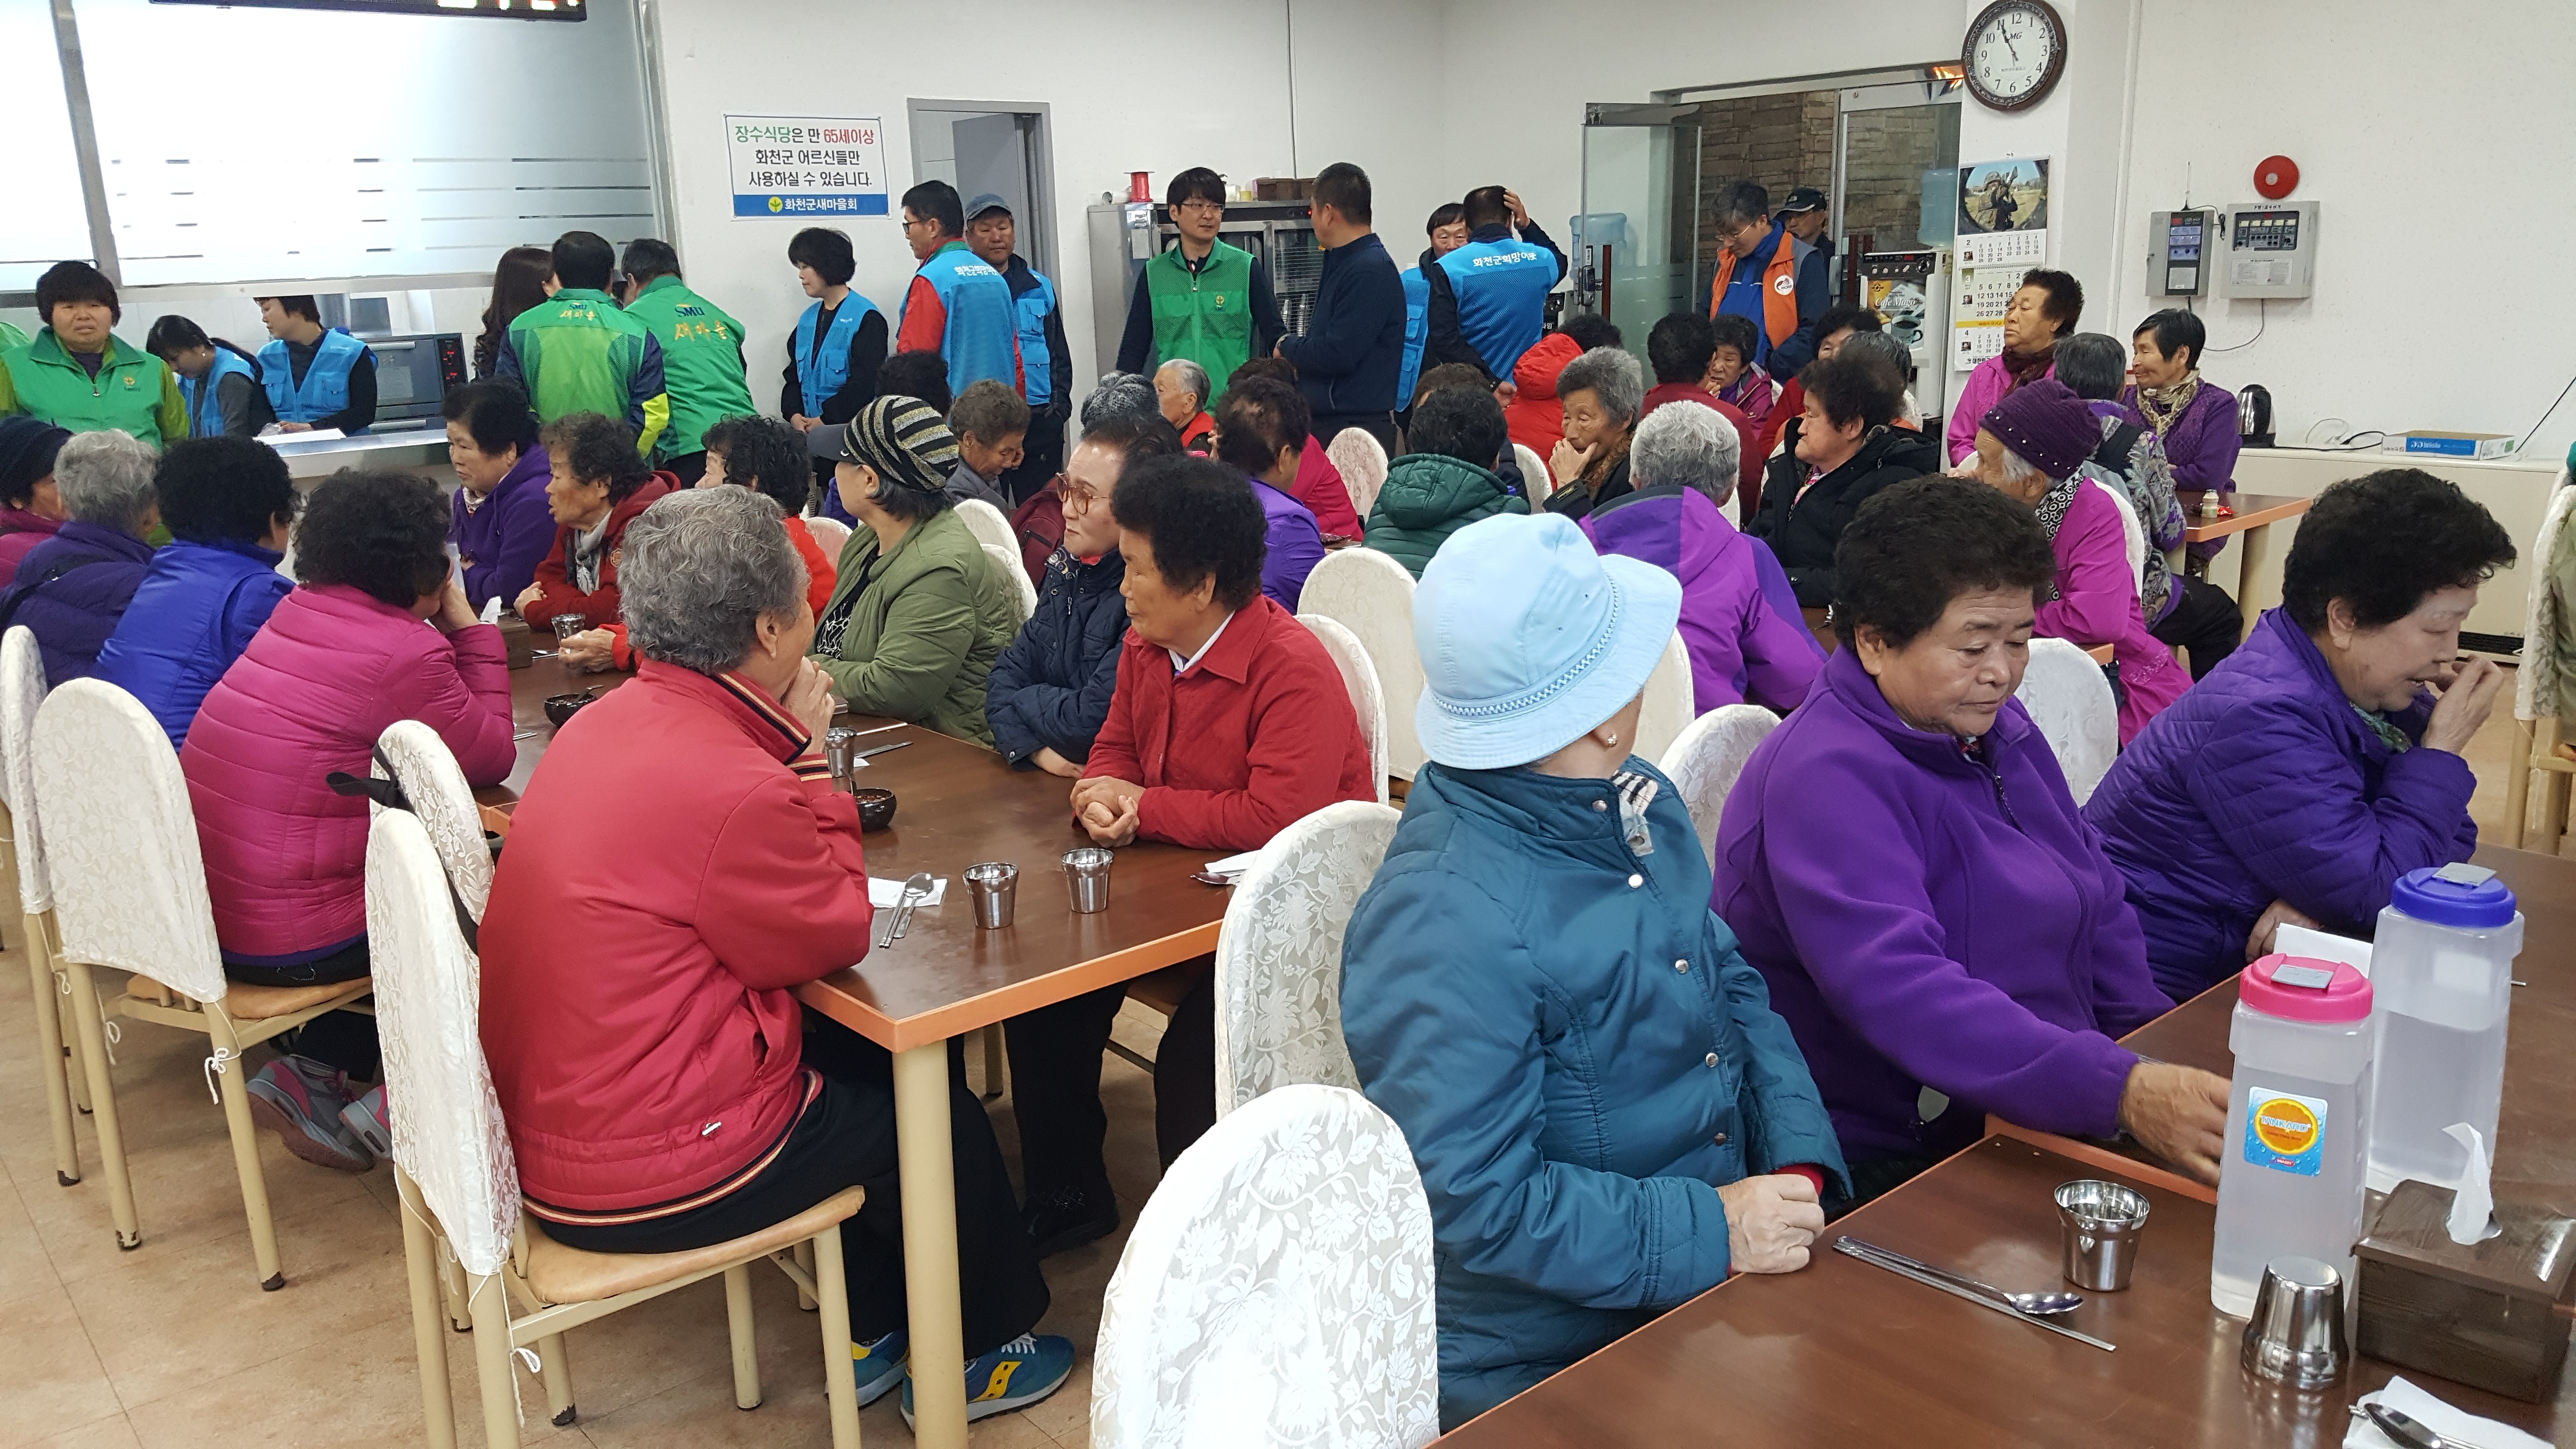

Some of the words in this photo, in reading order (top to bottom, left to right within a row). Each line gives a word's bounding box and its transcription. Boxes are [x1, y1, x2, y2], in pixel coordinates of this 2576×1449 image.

[2012, 13, 2022, 24] 12
[2029, 16, 2033, 28] 1
[1996, 19, 2005, 30] 11
[1985, 33, 1995, 44] 10
[2039, 28, 2045, 39] 2
[1981, 50, 1987, 62] 9
[2041, 46, 2047, 57] 3
[1984, 67, 1990, 78] 8
[2036, 62, 2042, 73] 4
[1995, 79, 2001, 90] 7
[2010, 81, 2016, 93] 6
[2025, 76, 2032, 87] 5
[735, 126, 804, 144] 장수식당은
[808, 129, 820, 144] 만
[824, 129, 874, 145] 65세이상
[756, 149, 793, 165] 화천군
[798, 150, 860, 165] 어르신들만
[749, 171, 799, 187] 사용하실
[804, 172, 816, 187] 수
[821, 172, 872, 187] 있습니다.
[785, 198, 857, 211] 화천군새마을회
[1472, 252, 1537, 267] 화천군희망이웃
[560, 310, 595, 321] 새마을
[675, 306, 705, 317] SMU
[675, 320, 727, 341] 새마을
[2260, 1115, 2308, 1133] TANKARD
